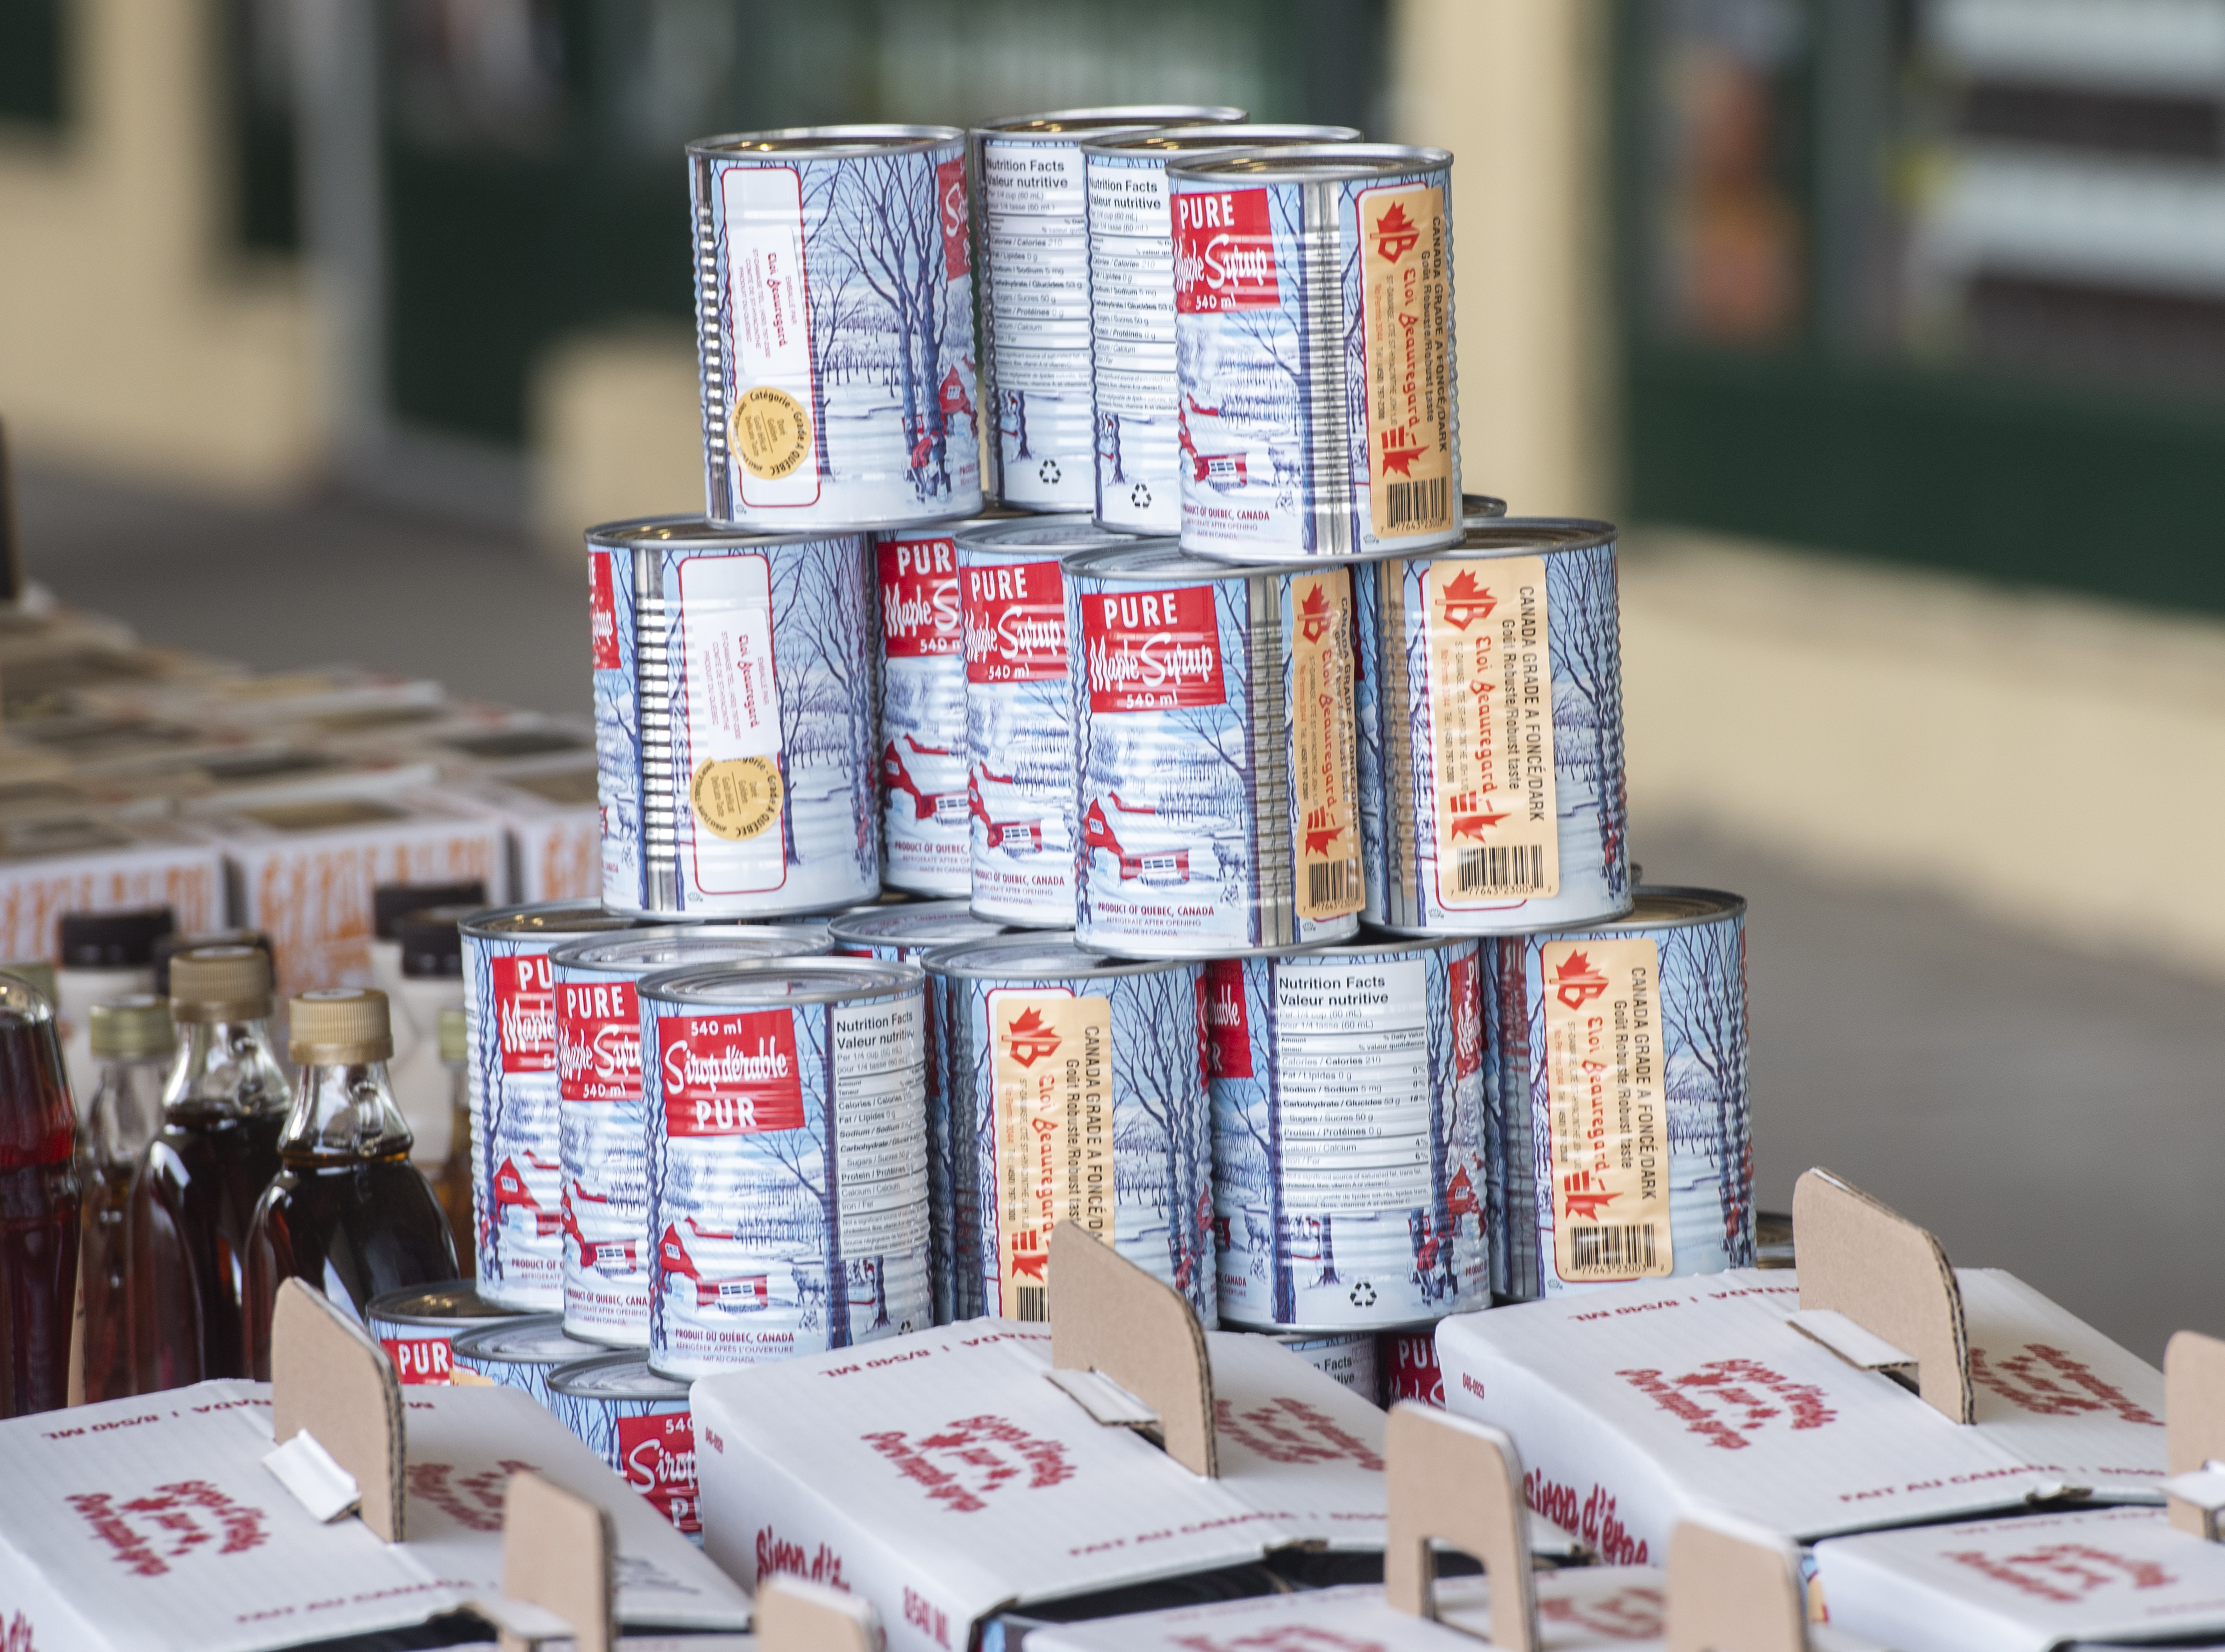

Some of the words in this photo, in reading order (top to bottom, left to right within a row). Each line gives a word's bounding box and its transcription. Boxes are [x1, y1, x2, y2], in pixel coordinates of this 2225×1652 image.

[986, 158, 1025, 171] Nutrition
[1030, 159, 1065, 172] Facts
[987, 174, 1013, 186] Valeur
[1017, 177, 1068, 188] nutritive
[1089, 176, 1122, 191] Nutrition
[1126, 179, 1158, 193] Facts
[1090, 193, 1111, 207] Valeur
[1114, 196, 1161, 210] nutritive
[1179, 193, 1235, 230] PURE
[1432, 216, 1441, 279] CANADA
[1173, 237, 1204, 293] Maple
[1205, 233, 1268, 290] Syrup
[1195, 294, 1217, 310] 540
[1221, 292, 1236, 309] ml
[1403, 267, 1417, 308] Eloi
[766, 279, 787, 348] Beauregard
[1434, 284, 1443, 336] GRADE
[1435, 340, 1443, 351] A
[1398, 313, 1420, 429] Beauregard
[750, 390, 790, 409] Catégorie
[1425, 390, 1435, 423] taste
[794, 411, 807, 441] Grade
[770, 449, 800, 477] QUÉBEC
[1237, 509, 1270, 521] CANADA
[897, 542, 952, 576] PUR
[971, 567, 1028, 602] PURE
[884, 582, 933, 639] Maple
[1103, 592, 1178, 630] PURE
[1519, 587, 1536, 648] CANADA
[964, 607, 998, 664] Maple
[997, 606, 1062, 660] Syrup
[1340, 597, 1350, 660] CANADA
[1502, 620, 1516, 649] Goût
[920, 638, 947, 653] 540
[1475, 636, 1492, 674] Eloi
[988, 666, 1010, 680] 540
[1013, 662, 1030, 679] ml
[1090, 635, 1139, 692] Maple
[1140, 632, 1213, 688] Syrup
[1322, 648, 1333, 686] Eloi
[1343, 663, 1353, 716] GRADE
[1522, 652, 1539, 705] GRADE
[737, 660, 760, 729] Beauregard
[1126, 693, 1155, 709] 540
[1160, 689, 1178, 706] ml
[1504, 653, 1521, 755] Robuste/Robust
[1524, 709, 1540, 720] A
[1318, 693, 1337, 808] Beauregard
[1469, 679, 1498, 794] Beauregard
[1508, 757, 1521, 790] taste
[1526, 724, 1546, 822] FONCÉ/DARK
[767, 774, 779, 805] Grade
[735, 813, 770, 838] QUÉBEC
[1031, 875, 1065, 886] CANADA
[1468, 888, 1498, 896] 77643
[1097, 900, 1127, 915] PRODUCT
[1128, 904, 1138, 916] OF
[1140, 905, 1174, 918] QUEBEC,
[1177, 905, 1215, 916] CANADA
[1106, 915, 1142, 926] REFRIGERATE
[1144, 918, 1163, 926] AFTER
[1166, 919, 1202, 927] OPENING
[1279, 976, 1341, 990] Nutrition
[1346, 976, 1386, 989] Facts
[566, 985, 625, 1019] PURE
[1279, 994, 1324, 1007] Valeur
[1329, 992, 1389, 1006] nutritive
[1631, 967, 1648, 1029] CANADA
[502, 998, 555, 1053] Maple
[691, 1020, 719, 1037] 540
[723, 1018, 742, 1035] ml
[836, 1017, 888, 1033] Nutrition
[892, 1010, 913, 1025] Facts
[1357, 1020, 1374, 1030] mL)
[1614, 1000, 1628, 1030] Goût
[837, 1036, 877, 1050] Valeur
[1587, 1016, 1605, 1054] Eloi
[559, 1024, 594, 1082] Maple
[593, 1023, 642, 1077] Syru
[665, 1040, 720, 1095] Sirop
[722, 1035, 789, 1084] d'érable
[1085, 1025, 1100, 1089] CANADA
[1282, 1057, 1317, 1066] Calories
[1325, 1056, 1363, 1065] Calories
[1365, 1055, 1381, 1064] 210
[1634, 1034, 1651, 1085] GRADE
[837, 1066, 854, 1076] pour
[1066, 1059, 1080, 1088] Goût
[1283, 1071, 1296, 1079] Fat
[1303, 1071, 1336, 1082] Lipides
[1615, 1033, 1633, 1134] Robuste/Robust
[583, 1083, 606, 1098] 540
[610, 1081, 626, 1097] ml
[1039, 1074, 1055, 1111] Eloi
[1283, 1098, 1340, 1109] Carbohydrate
[1345, 1096, 1382, 1107] Glucides
[1284, 1084, 1316, 1093] Sodium
[1324, 1084, 1359, 1093] Sodium
[1637, 1089, 1652, 1099] A
[696, 1097, 757, 1131] PUR
[839, 1100, 871, 1110] Calories
[1086, 1093, 1102, 1145] GRADE
[1289, 1113, 1318, 1124] Sugars
[1325, 1113, 1354, 1122] Sucres
[1581, 1059, 1610, 1173] Beauregard
[839, 1116, 852, 1124] Fat
[839, 1128, 870, 1138] Sodium
[1284, 1128, 1315, 1136] Protein
[1323, 1126, 1367, 1136] Protéines
[840, 1141, 888, 1153] Carbohydrate
[1066, 1093, 1081, 1195] Robuste/Robust
[1087, 1149, 1102, 1160] A
[1284, 1143, 1316, 1153] Calcium
[1323, 1142, 1357, 1153] Calcium
[1620, 1138, 1633, 1170] taste
[1638, 1104, 1658, 1201] FONCÉ/DARK
[841, 1171, 871, 1182] Protein
[841, 1186, 871, 1197] Calcium
[511, 1257, 543, 1270] PRODUCT
[547, 1259, 556, 1271] OF
[1581, 1265, 1611, 1275] 77643
[1617, 1264, 1647, 1275] 23003
[596, 1293, 624, 1308] QUEBEC,
[625, 1295, 648, 1307] CANA
[1567, 1310, 1611, 1322] ML
[675, 1328, 704, 1342] PRODUIT
[706, 1331, 717, 1342] DU
[719, 1329, 754, 1345] QUÉBEC,
[756, 1332, 794, 1343] CANADA
[713, 1344, 737, 1353] APRÈS
[739, 1344, 794, 1354] L'OUVERTURE
[818, 1364, 863, 1378] ML
[1324, 1356, 1353, 1372] Facts
[1462, 1372, 1485, 1401] 046-0929
